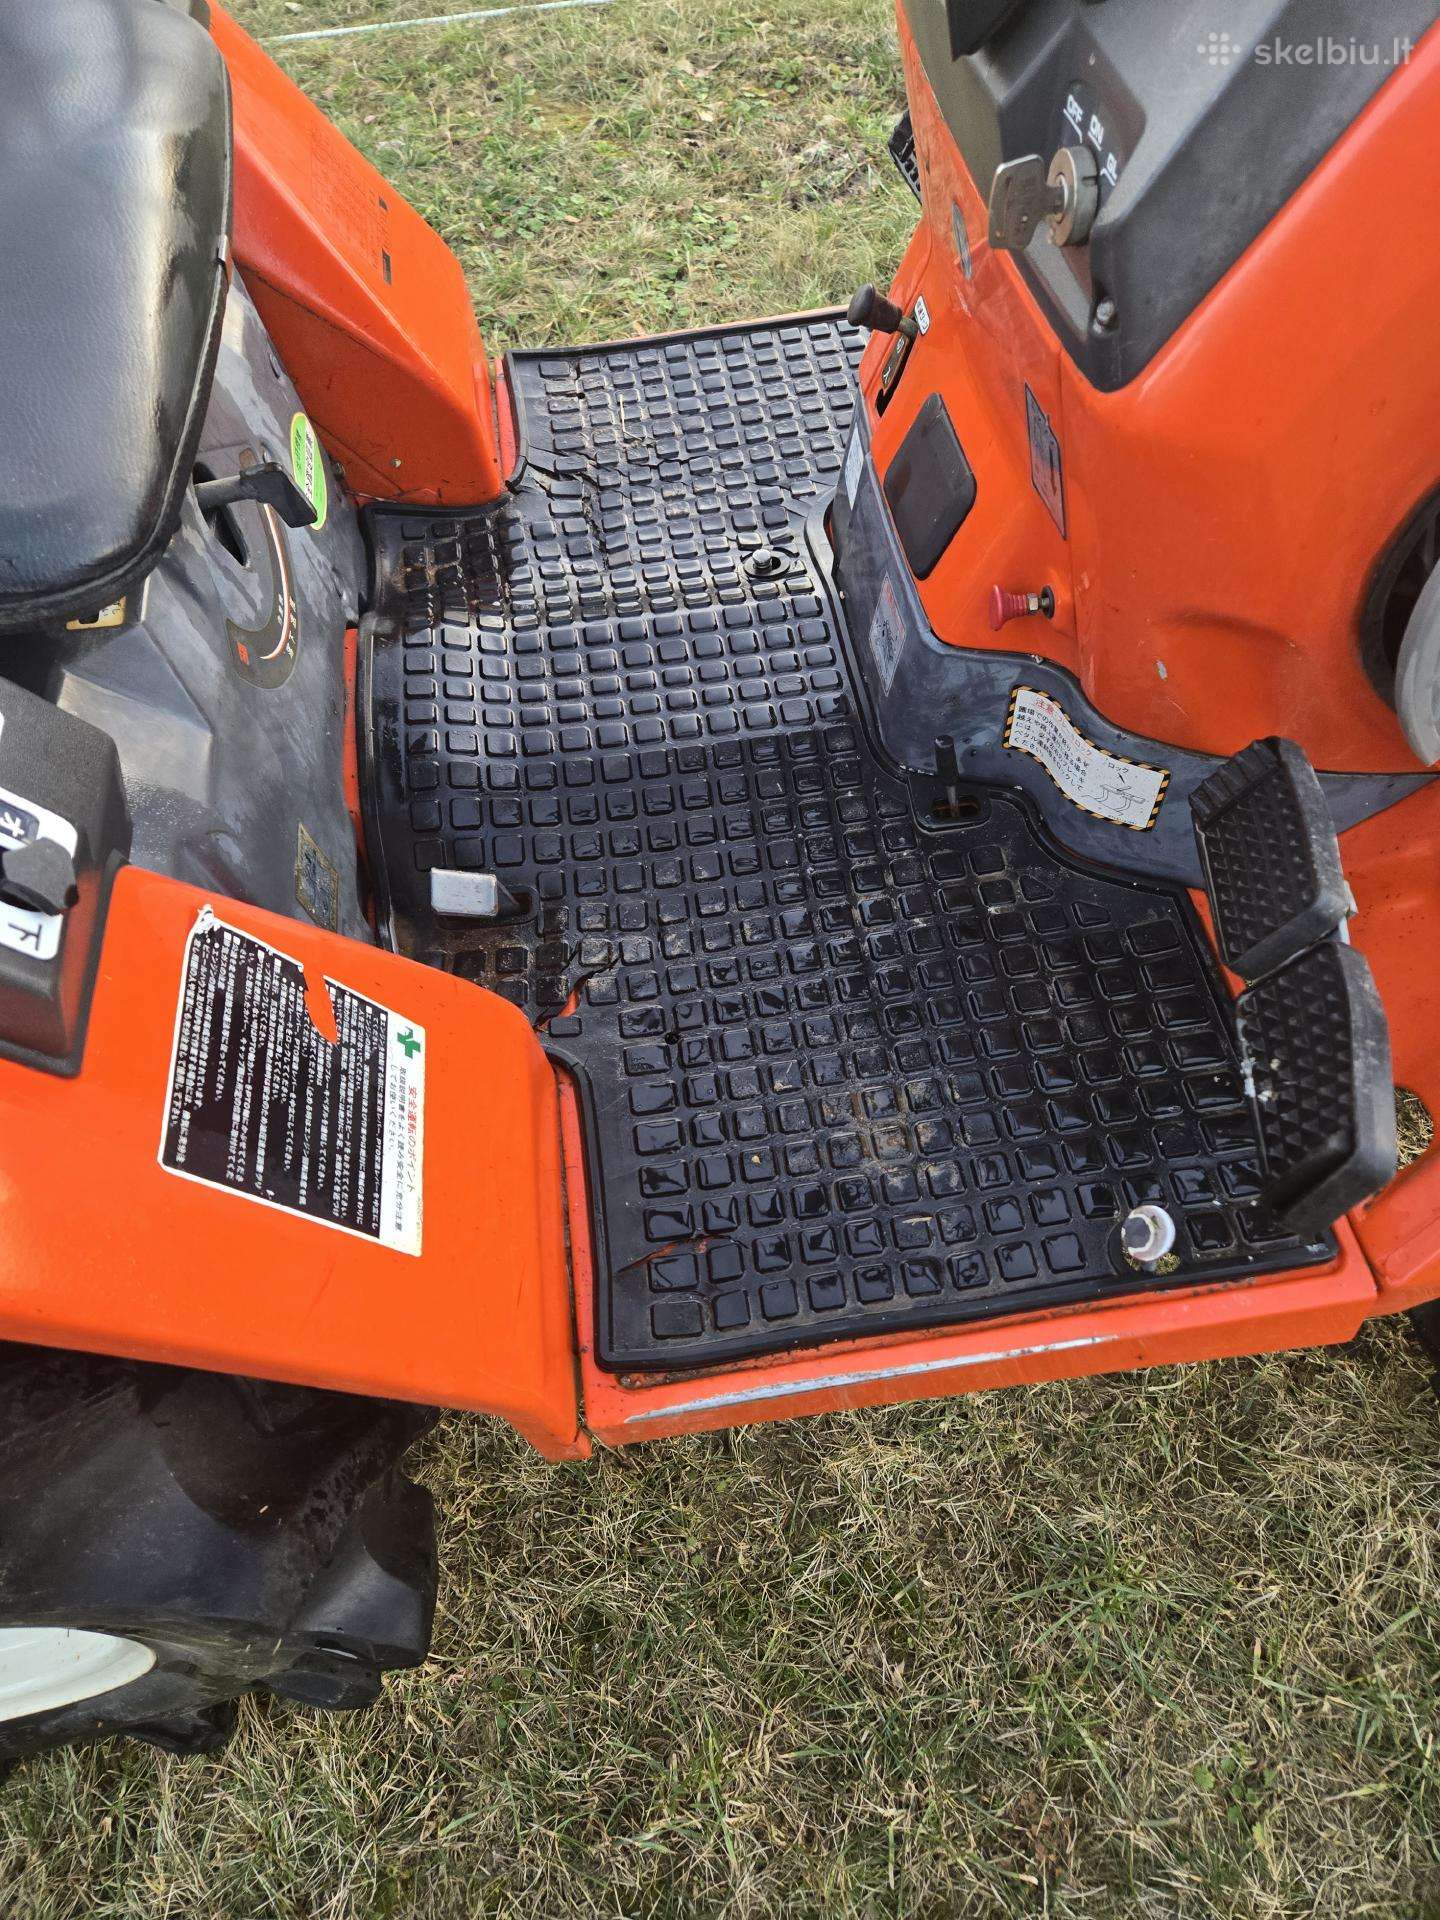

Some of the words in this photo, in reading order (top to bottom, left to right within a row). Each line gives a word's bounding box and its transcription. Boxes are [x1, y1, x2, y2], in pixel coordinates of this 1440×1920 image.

[1066, 93, 1083, 124] OFF
[1089, 113, 1104, 145] ON
[8, 923, 42, 952] 下
